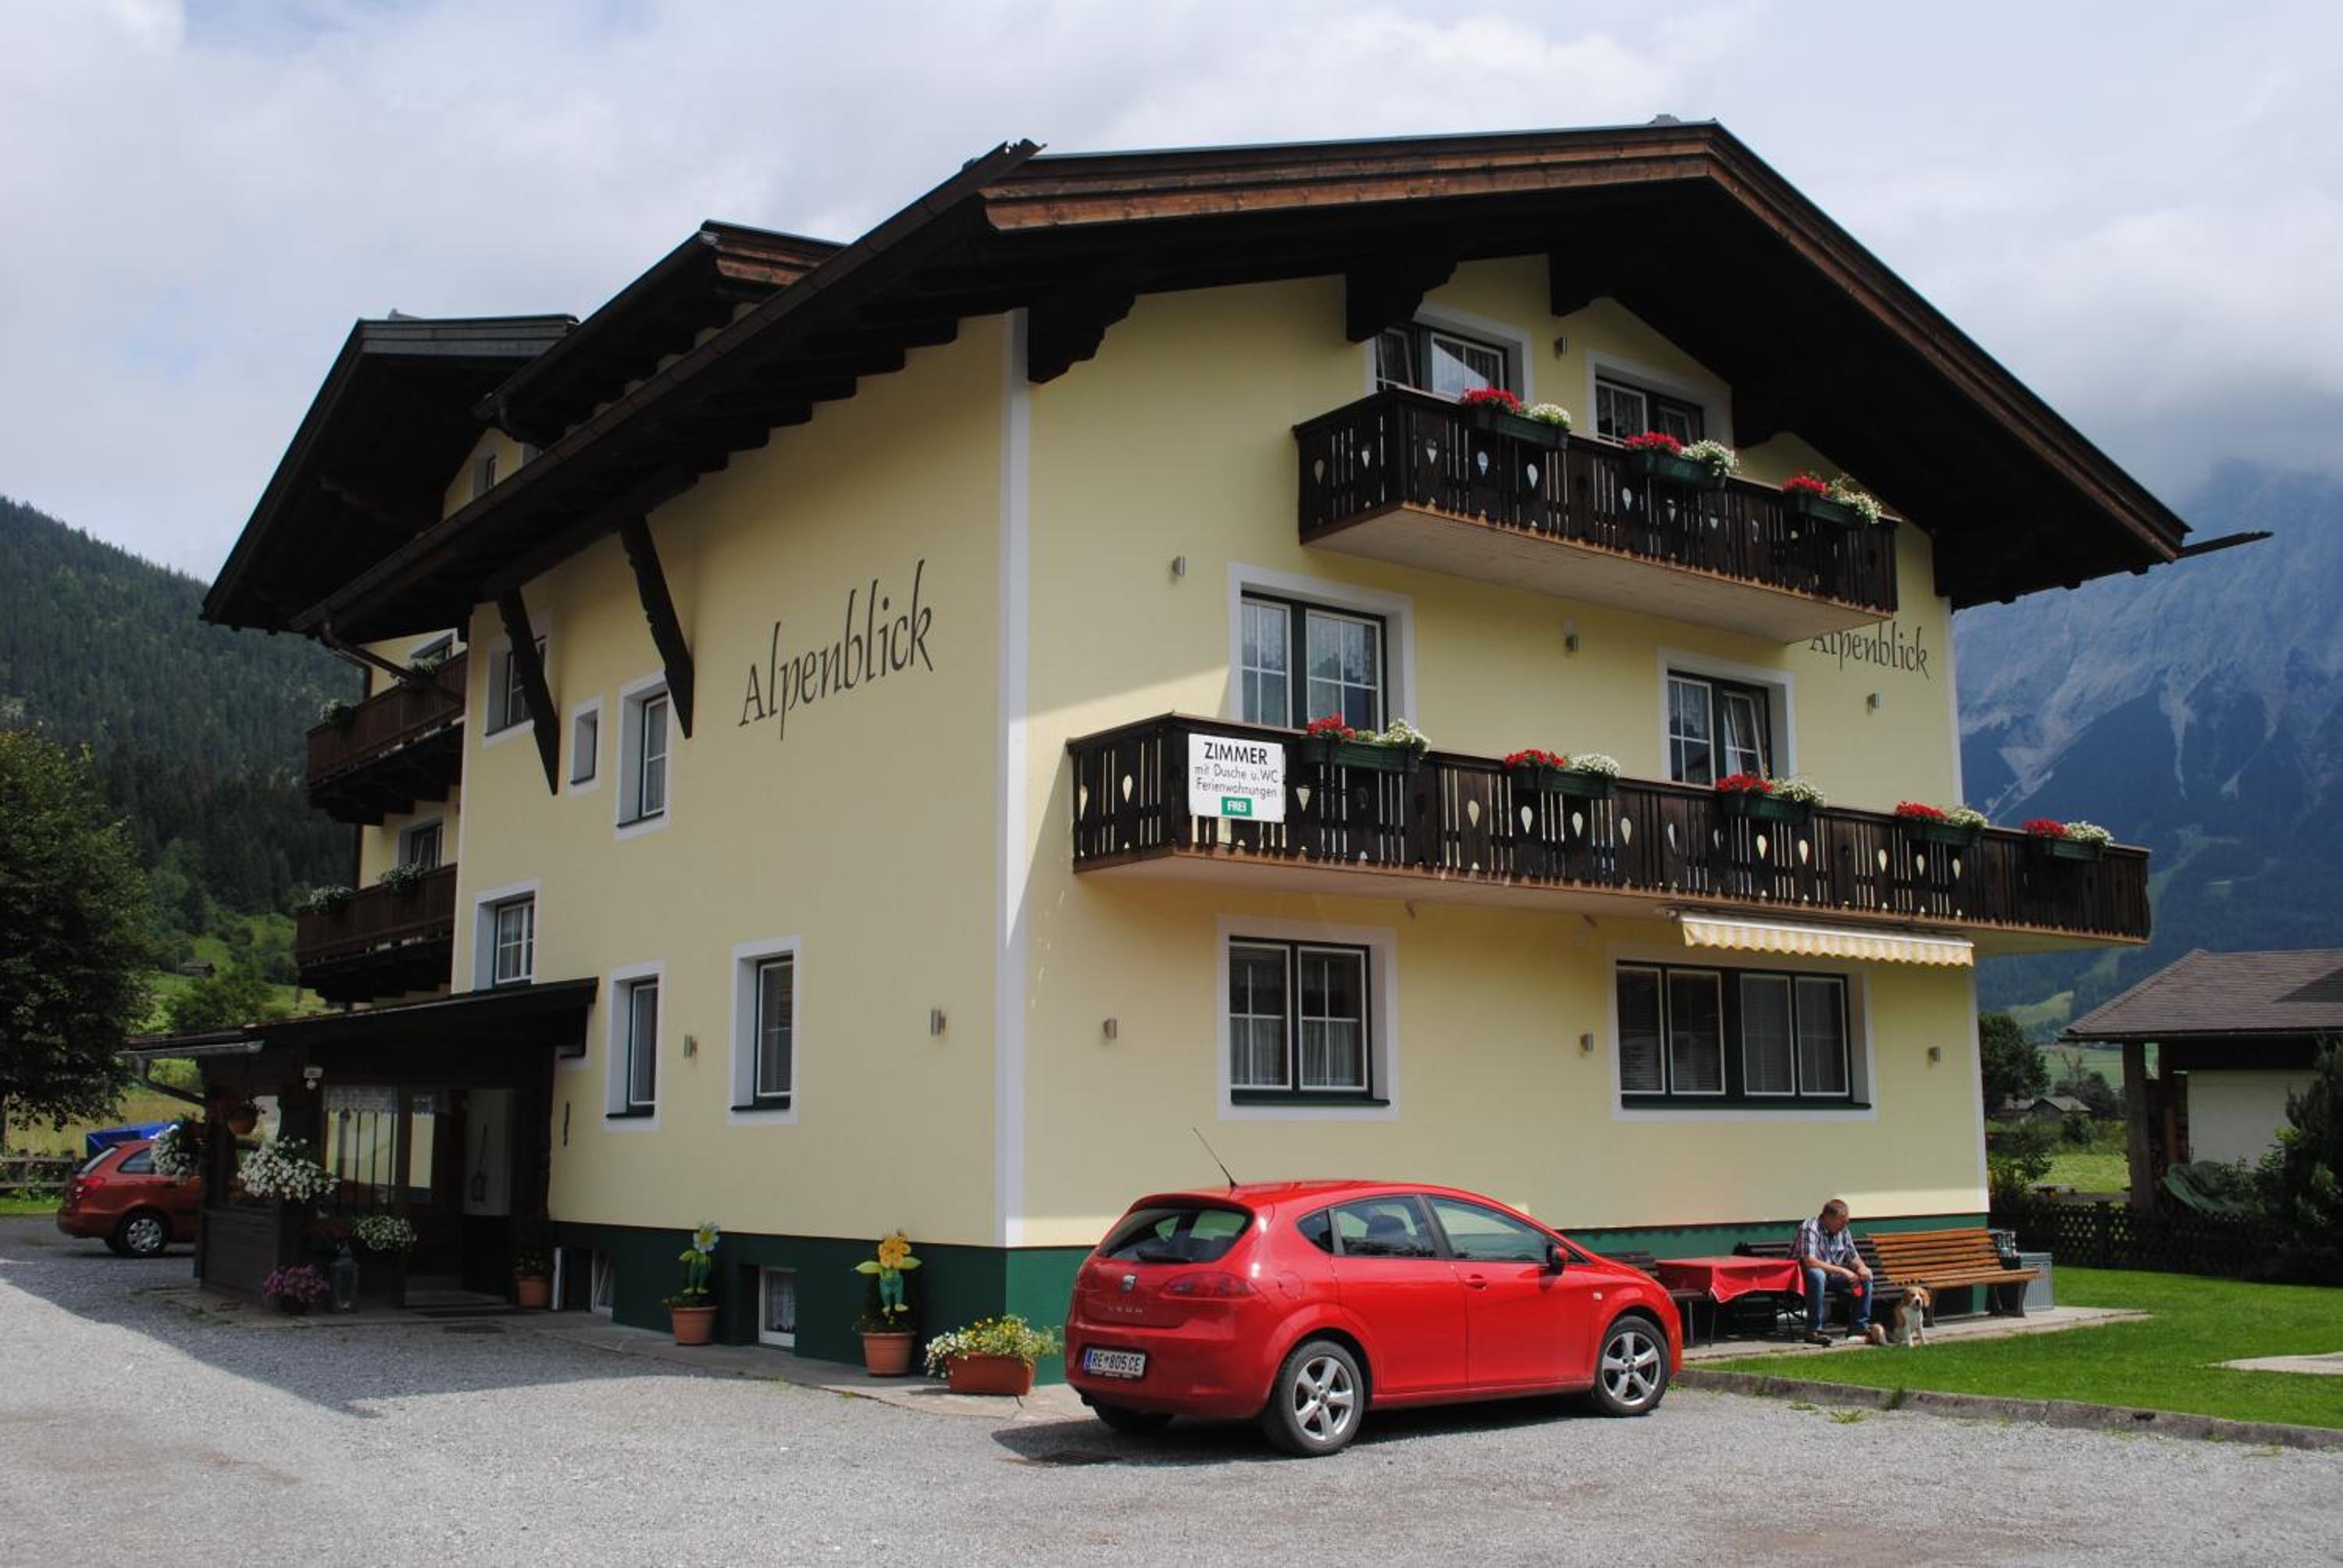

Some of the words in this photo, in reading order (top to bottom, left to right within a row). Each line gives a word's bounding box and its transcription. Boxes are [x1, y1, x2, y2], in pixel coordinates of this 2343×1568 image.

[738, 558, 933, 741] Alpenblick
[1204, 741, 1268, 765] ZIMMER
[1194, 764, 1210, 775] mit
[1213, 763, 1247, 779] Dusche
[1196, 777, 1277, 800] Ferienwohnungen
